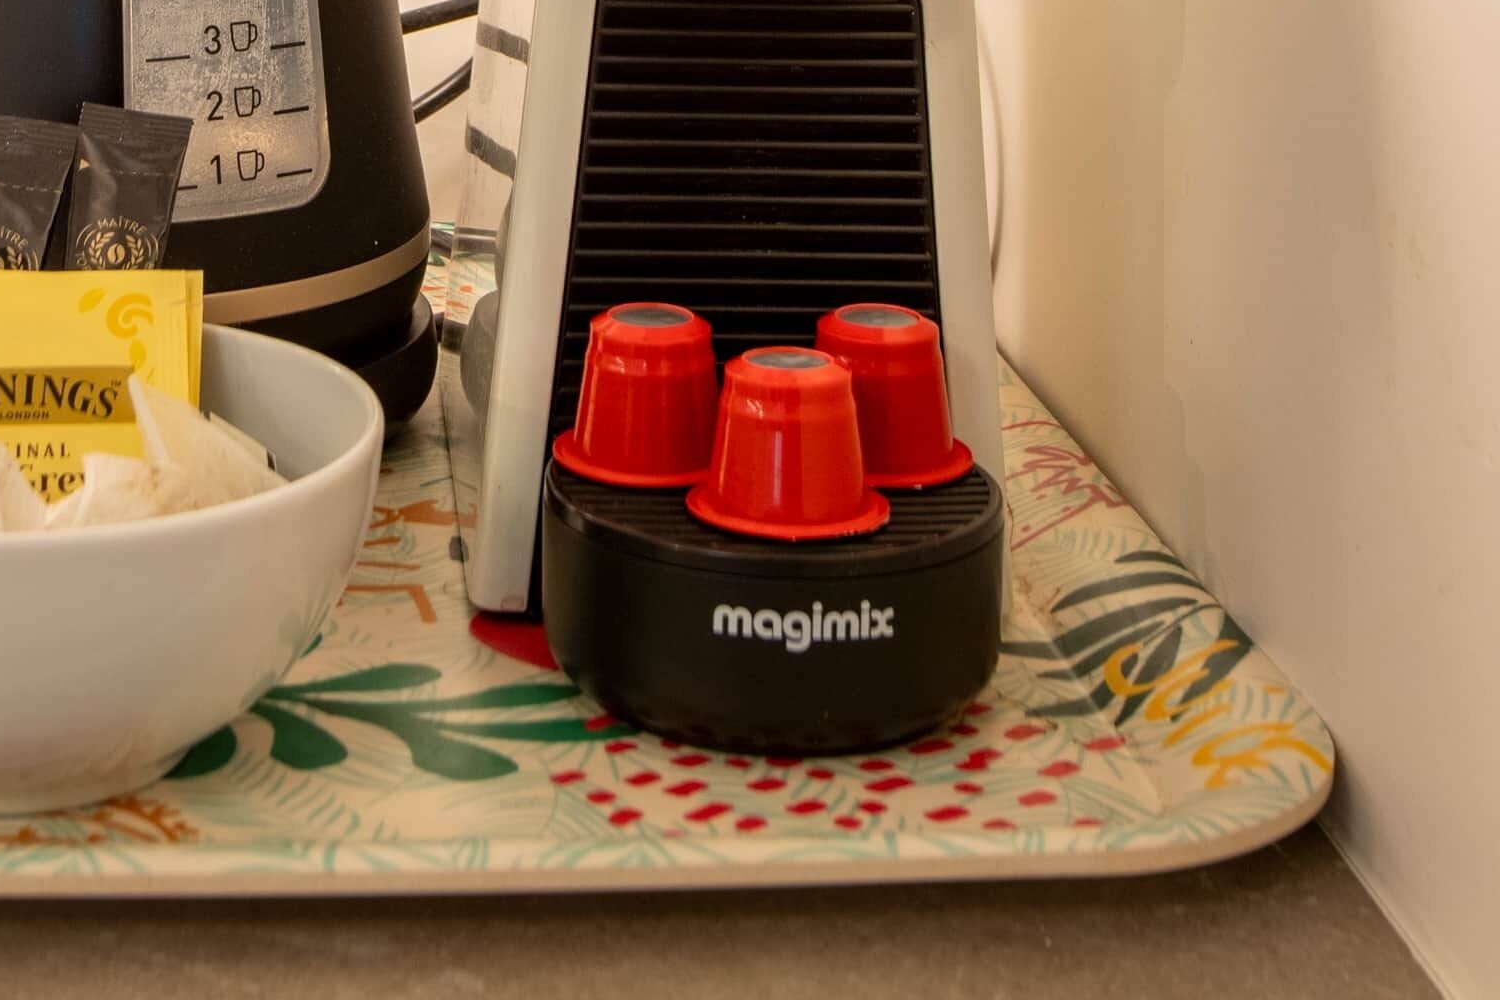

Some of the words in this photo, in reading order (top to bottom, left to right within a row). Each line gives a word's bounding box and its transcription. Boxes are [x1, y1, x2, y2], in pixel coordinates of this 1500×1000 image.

[203, 25, 222, 55] 3
[207, 92, 224, 121] 2
[210, 155, 223, 184] 1
[0, 410, 50, 420] LONDON
[712, 599, 894, 653] magimix
